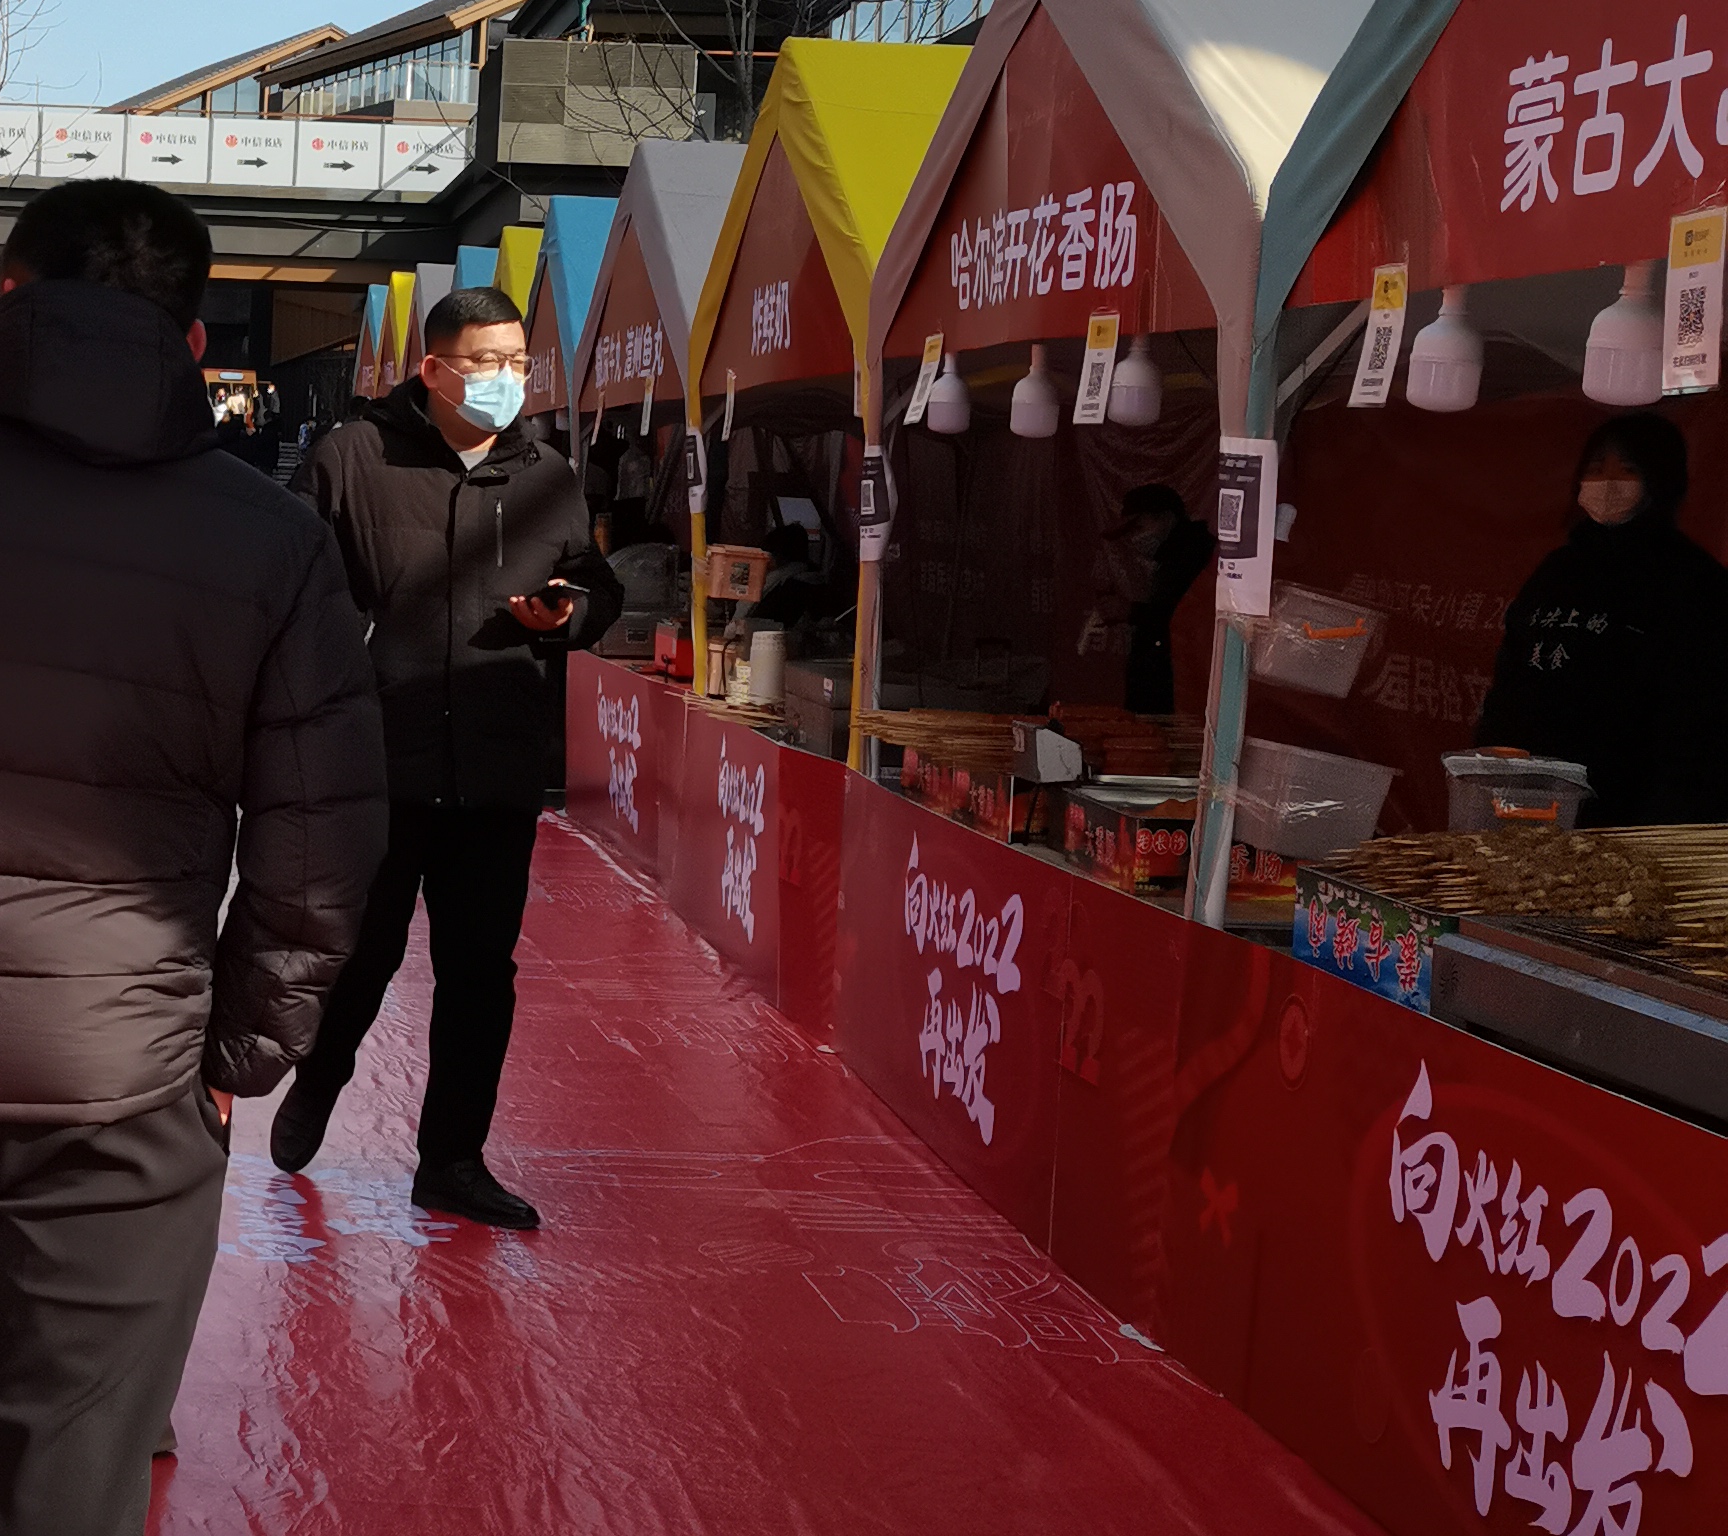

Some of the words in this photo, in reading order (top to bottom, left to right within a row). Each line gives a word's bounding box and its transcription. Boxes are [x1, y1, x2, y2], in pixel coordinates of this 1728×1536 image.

[1501, 14, 1728, 213] 蒙古大
[950, 180, 1137, 311] 哈尔滨开花香肠
[905, 830, 1023, 993] 向火红2022
[919, 967, 1000, 1146] 再出发
[1388, 1058, 1728, 1395] 向火红2022
